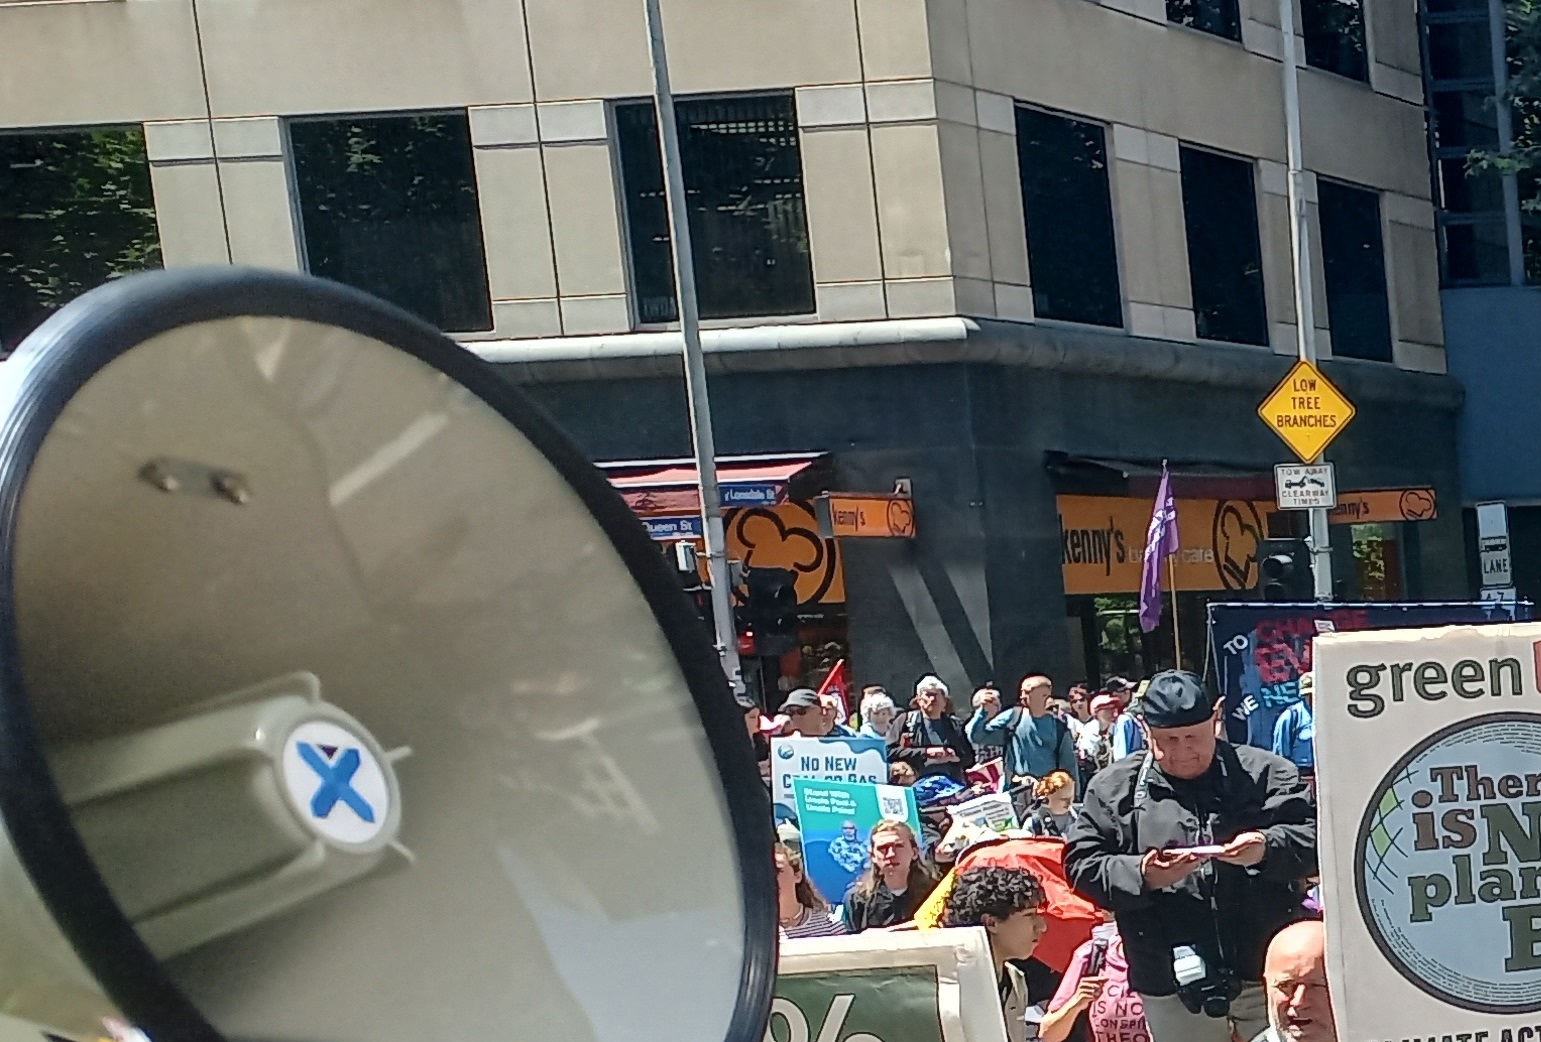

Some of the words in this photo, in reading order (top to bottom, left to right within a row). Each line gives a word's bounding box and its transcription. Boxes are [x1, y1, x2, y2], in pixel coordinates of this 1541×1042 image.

[1293, 378, 1316, 392] LOW
[1291, 397, 1321, 410] TREE
[1276, 414, 1337, 428] BRANCHES
[832, 505, 866, 532] kenny's
[1059, 513, 1126, 577] kenny's
[1484, 558, 1508, 575] LANE
[1224, 634, 1249, 657] TO
[1346, 657, 1523, 720] green
[1231, 694, 1260, 722] WE
[800, 756, 820, 772] NO
[824, 755, 857, 772] NEW
[1410, 790, 1478, 852] is
